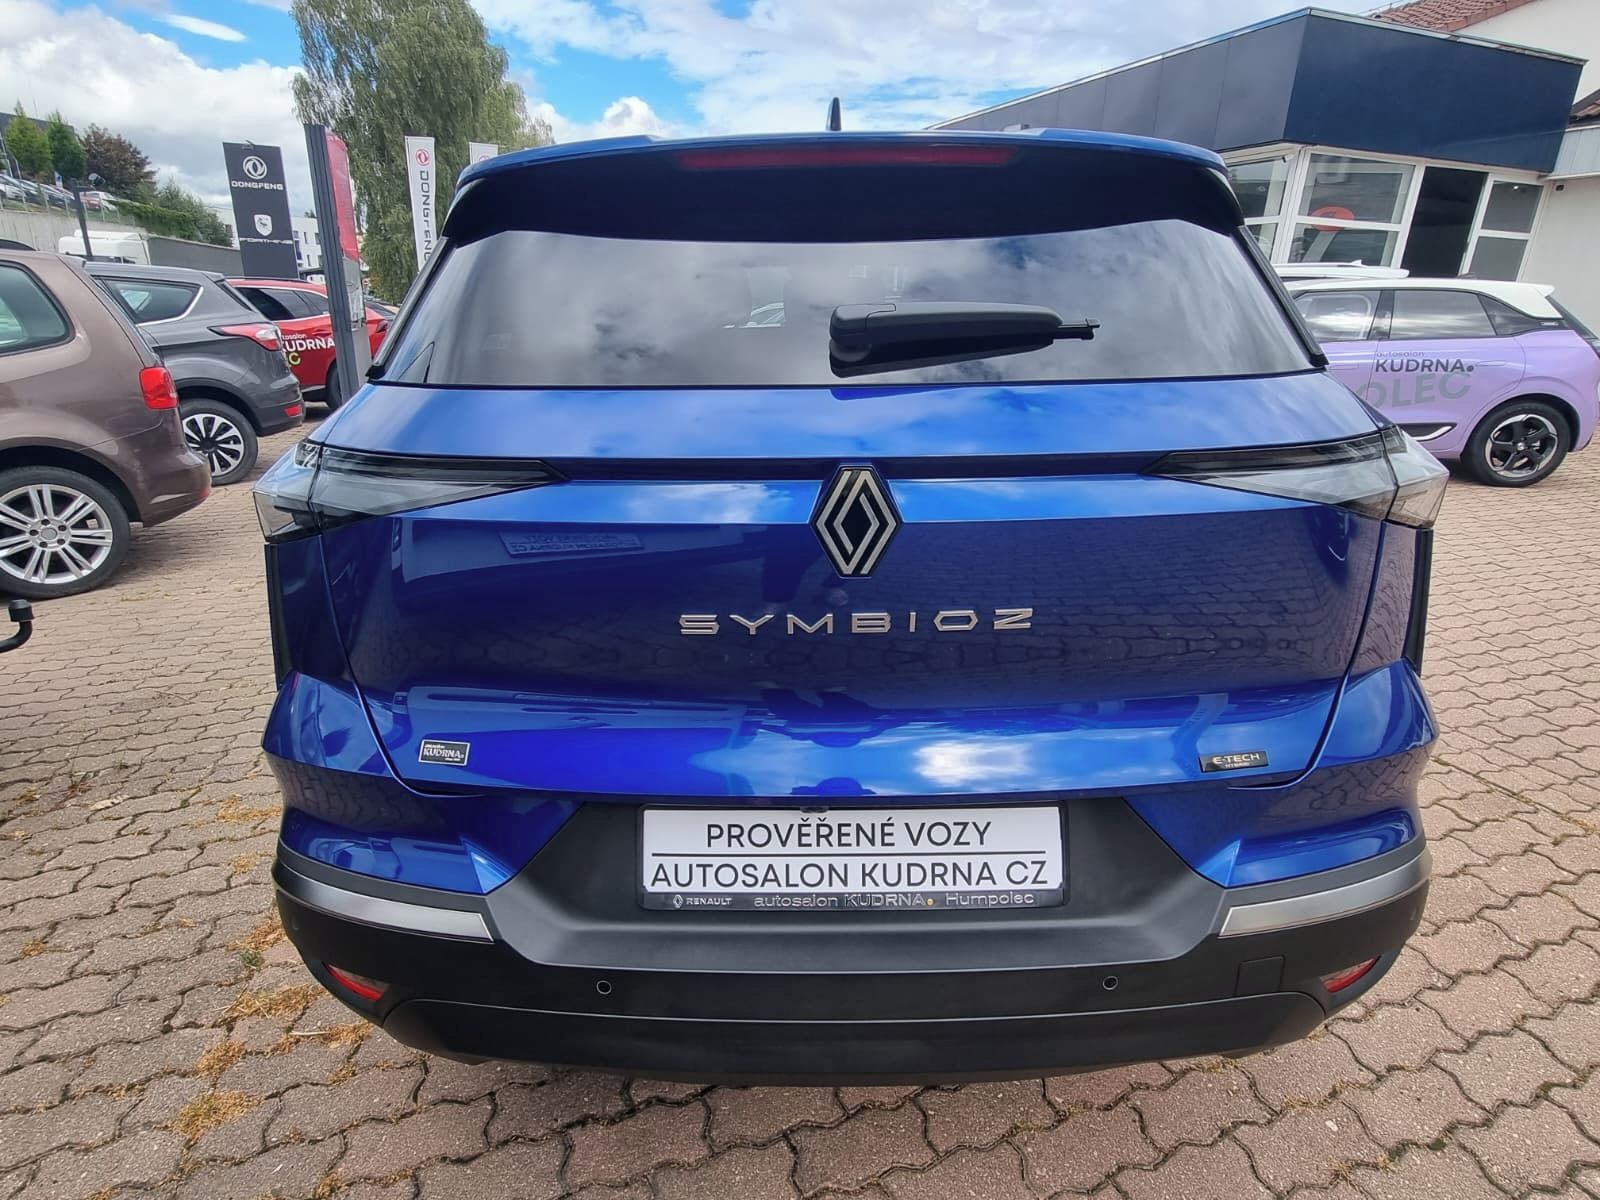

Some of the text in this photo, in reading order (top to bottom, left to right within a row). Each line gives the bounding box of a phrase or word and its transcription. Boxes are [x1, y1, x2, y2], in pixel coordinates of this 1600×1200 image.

[231, 180, 284, 191] DONGFENG
[679, 607, 1034, 635] SYMBIOZ
[706, 816, 993, 849] PROVĚŘENÉ VOZY
[650, 860, 1049, 889] AUTOSALON KUDRNA CZ
[686, 897, 733, 906] RENAULT
[754, 894, 838, 908] autosalon
[945, 891, 1035, 908] Humpolec
